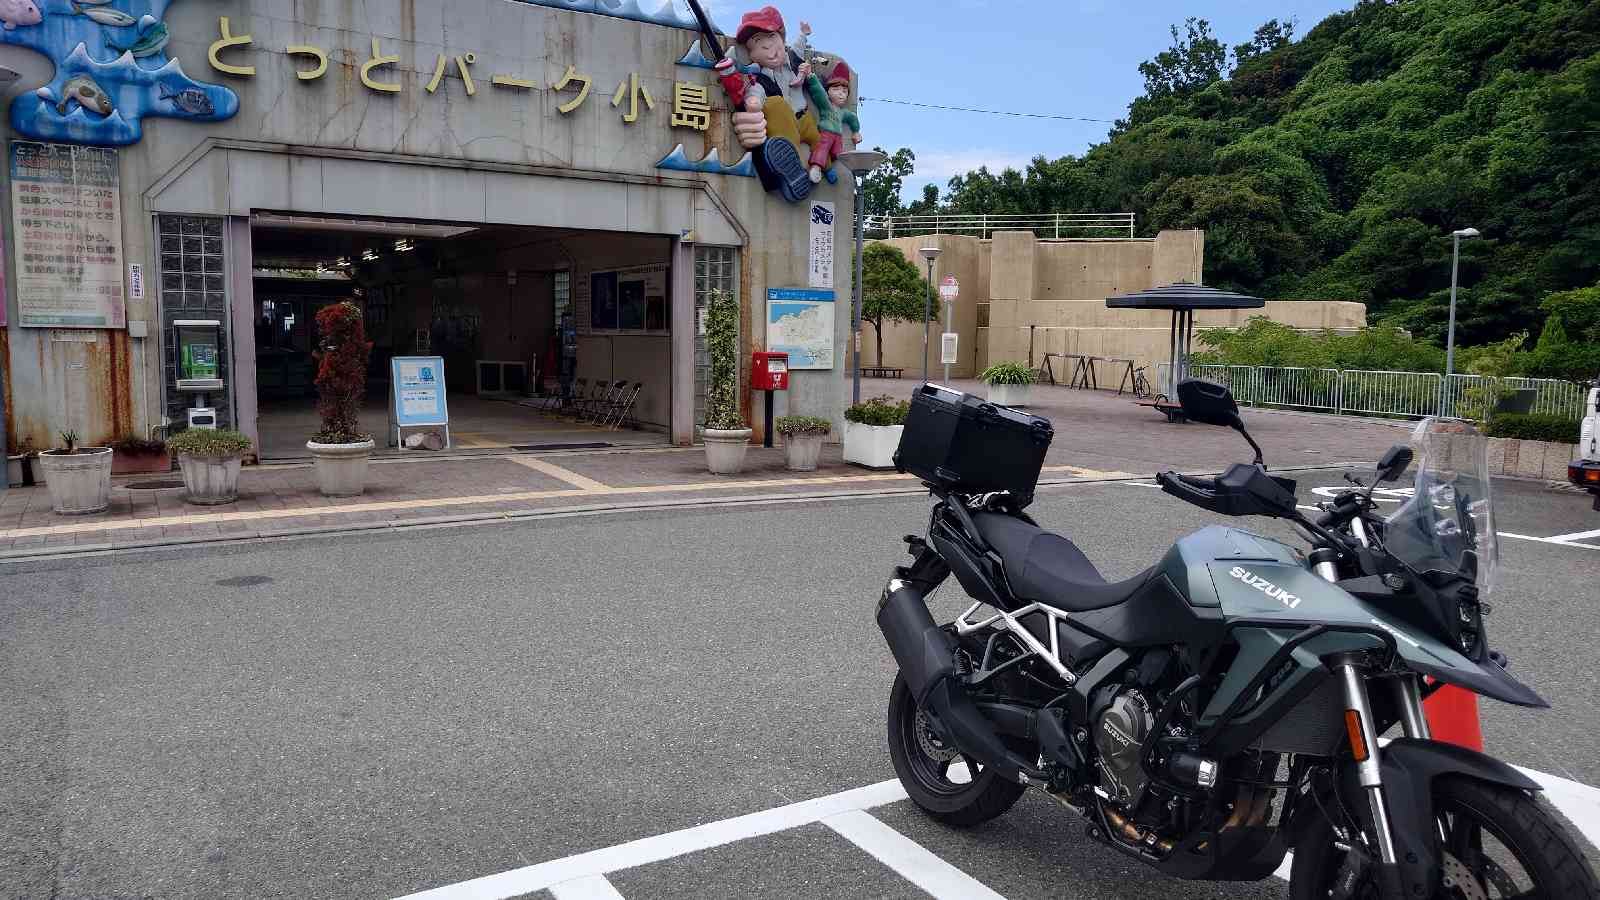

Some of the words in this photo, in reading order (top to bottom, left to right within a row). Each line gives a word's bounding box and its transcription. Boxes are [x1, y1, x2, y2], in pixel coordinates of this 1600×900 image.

[208, 16, 711, 131] とっとパーク小島
[1229, 566, 1301, 609] SUZUKI
[1103, 722, 1130, 748] SUZUKI
